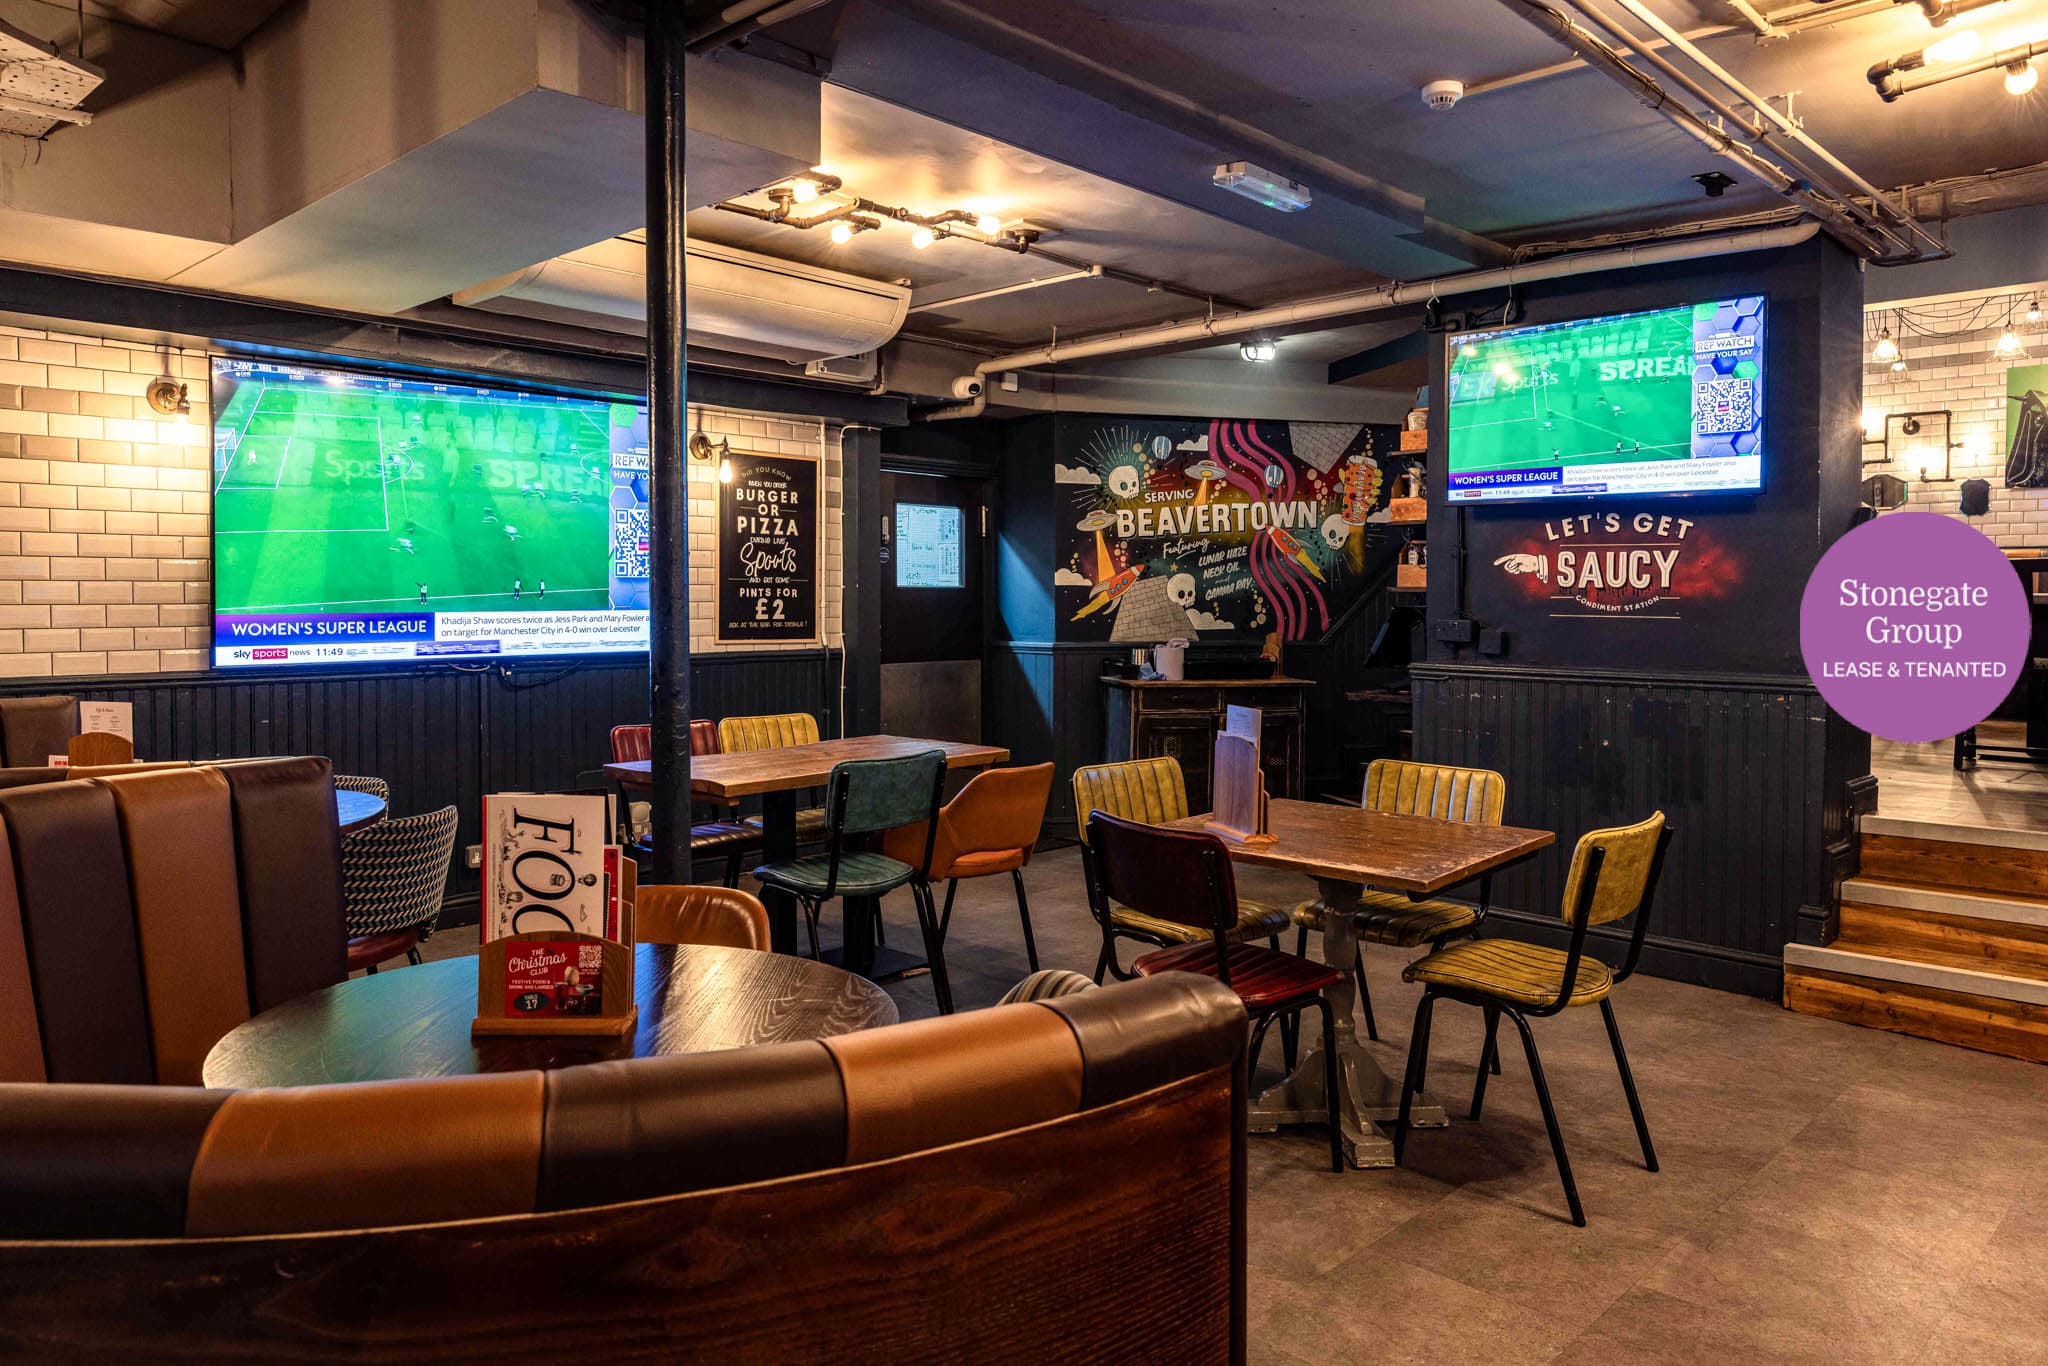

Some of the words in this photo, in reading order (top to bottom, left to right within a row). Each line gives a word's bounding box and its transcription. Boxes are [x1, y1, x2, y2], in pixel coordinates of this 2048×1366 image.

[1697, 341, 1714, 351] REF
[1716, 337, 1752, 348] WATCH
[1696, 352, 1717, 361] HAVE
[1717, 350, 1738, 358] YOUR
[1739, 348, 1754, 356] SAY
[615, 455, 634, 467] REF
[614, 471, 635, 480] HAVE
[741, 469, 753, 478] DID
[772, 468, 792, 481] KNOW
[1455, 475, 1495, 485] WOMEN'S
[1496, 474, 1522, 483] SUPER
[1524, 472, 1559, 482] LEAGUE
[736, 487, 799, 504] BURGER
[1144, 489, 1195, 503] SERVING
[757, 503, 780, 517] OR
[737, 515, 799, 536] PIZZA
[1116, 500, 1318, 538] BEAVERTOWN
[1544, 512, 1620, 541] LET'S
[1633, 512, 1694, 540] GET
[1163, 537, 1210, 559] Featuring
[740, 541, 797, 578] Sports
[1198, 551, 1225, 567] LUNAR
[1226, 546, 1248, 560] HAZE
[1202, 565, 1224, 580] NECK
[1226, 561, 1240, 573] OIL
[1556, 549, 1680, 589] SAUCY
[739, 587, 772, 598] PINTS
[776, 587, 798, 598] FOR
[1205, 583, 1234, 600] GAMMA
[1235, 577, 1253, 592] RAY
[755, 597, 785, 620] £2
[1575, 594, 1622, 612] CONDIMENT
[1623, 595, 1660, 612] STATION
[441, 616, 472, 626] Khadija
[473, 616, 495, 625] Shaw
[523, 616, 543, 624] twice
[554, 615, 570, 623] Jess
[603, 615, 621, 623] Mary
[622, 614, 644, 622] Fowler
[231, 622, 313, 637] WOMEN'S
[316, 621, 366, 635] SUPER
[369, 620, 427, 634] LEAGUE
[441, 629, 452, 637] on
[453, 628, 480, 638] target
[480, 627, 492, 635] for
[493, 626, 539, 635] Manchester
[540, 626, 555, 635] City
[609, 625, 641, 633] Leicester
[233, 649, 250, 660] sky
[254, 648, 287, 659] sports
[289, 648, 311, 657] news
[316, 647, 344, 657] 11:49
[531, 948, 545, 956] THE
[508, 952, 567, 973] Christmas
[530, 967, 549, 976] CLUB
[525, 999, 538, 1010] 17
